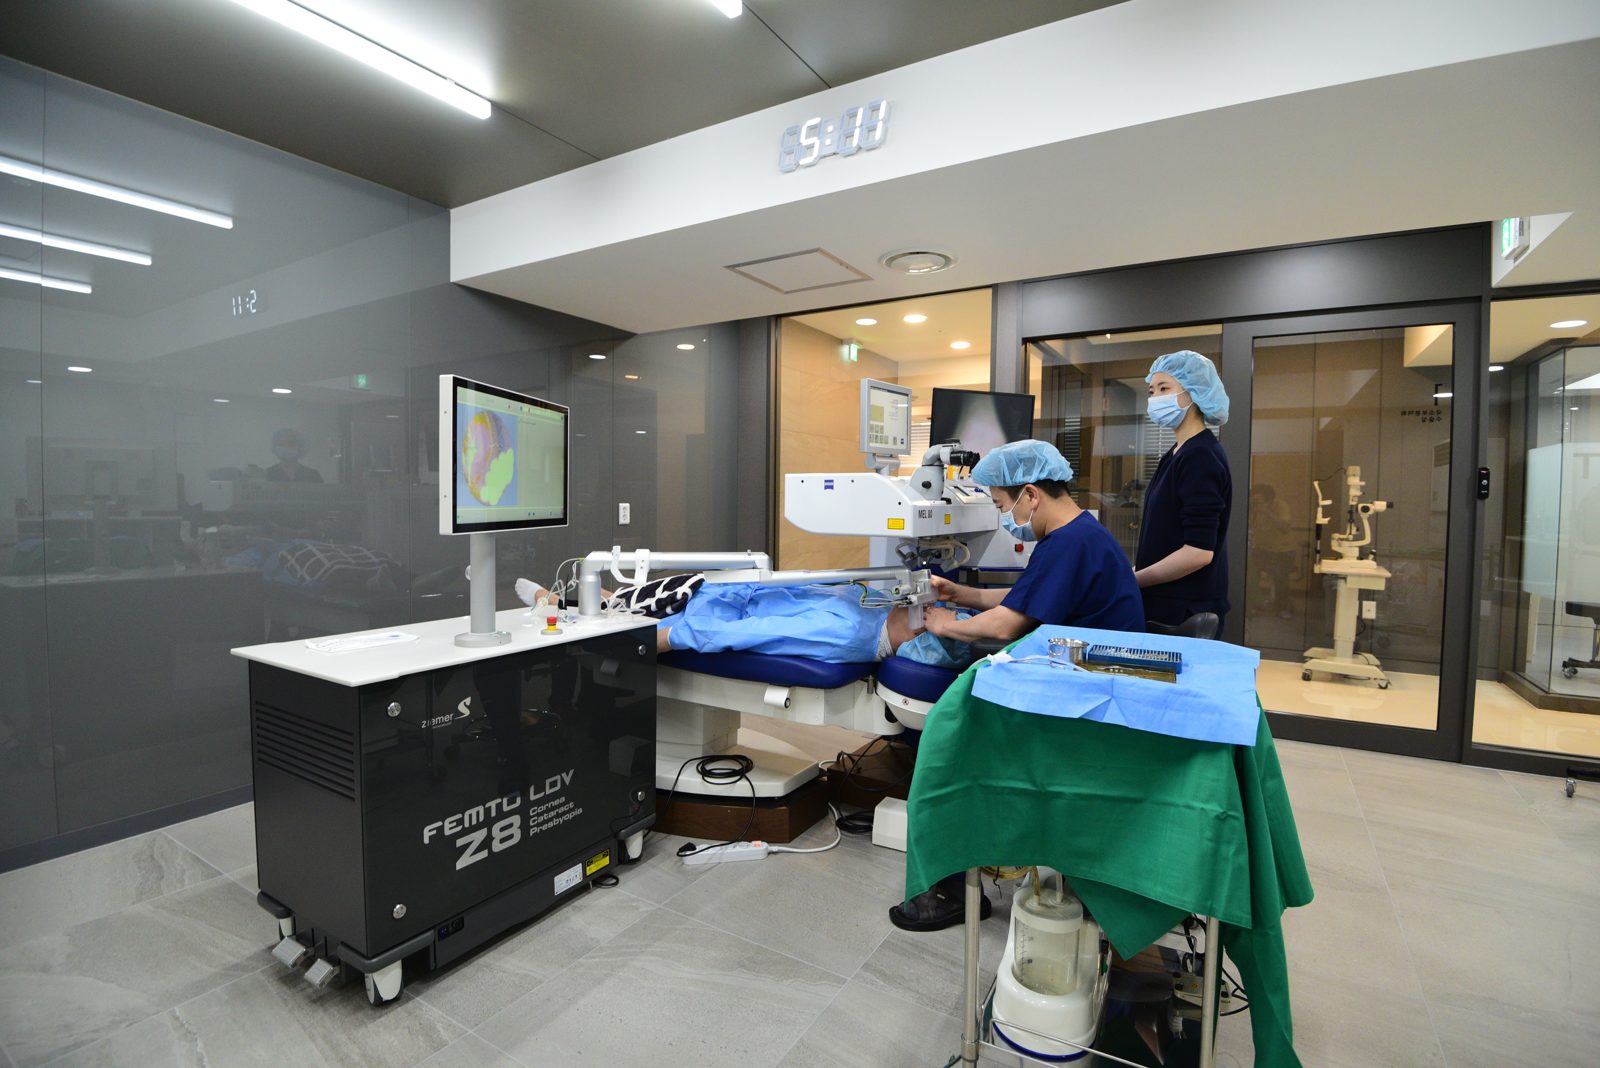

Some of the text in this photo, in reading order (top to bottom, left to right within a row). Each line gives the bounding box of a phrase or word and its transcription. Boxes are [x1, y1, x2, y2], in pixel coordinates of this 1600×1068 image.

[423, 768, 575, 845] FEMTO LDV
[529, 796, 566, 816] Cornea
[529, 801, 575, 827] Cataract
[529, 807, 583, 837] Presbyopia
[455, 814, 522, 871] Z8
